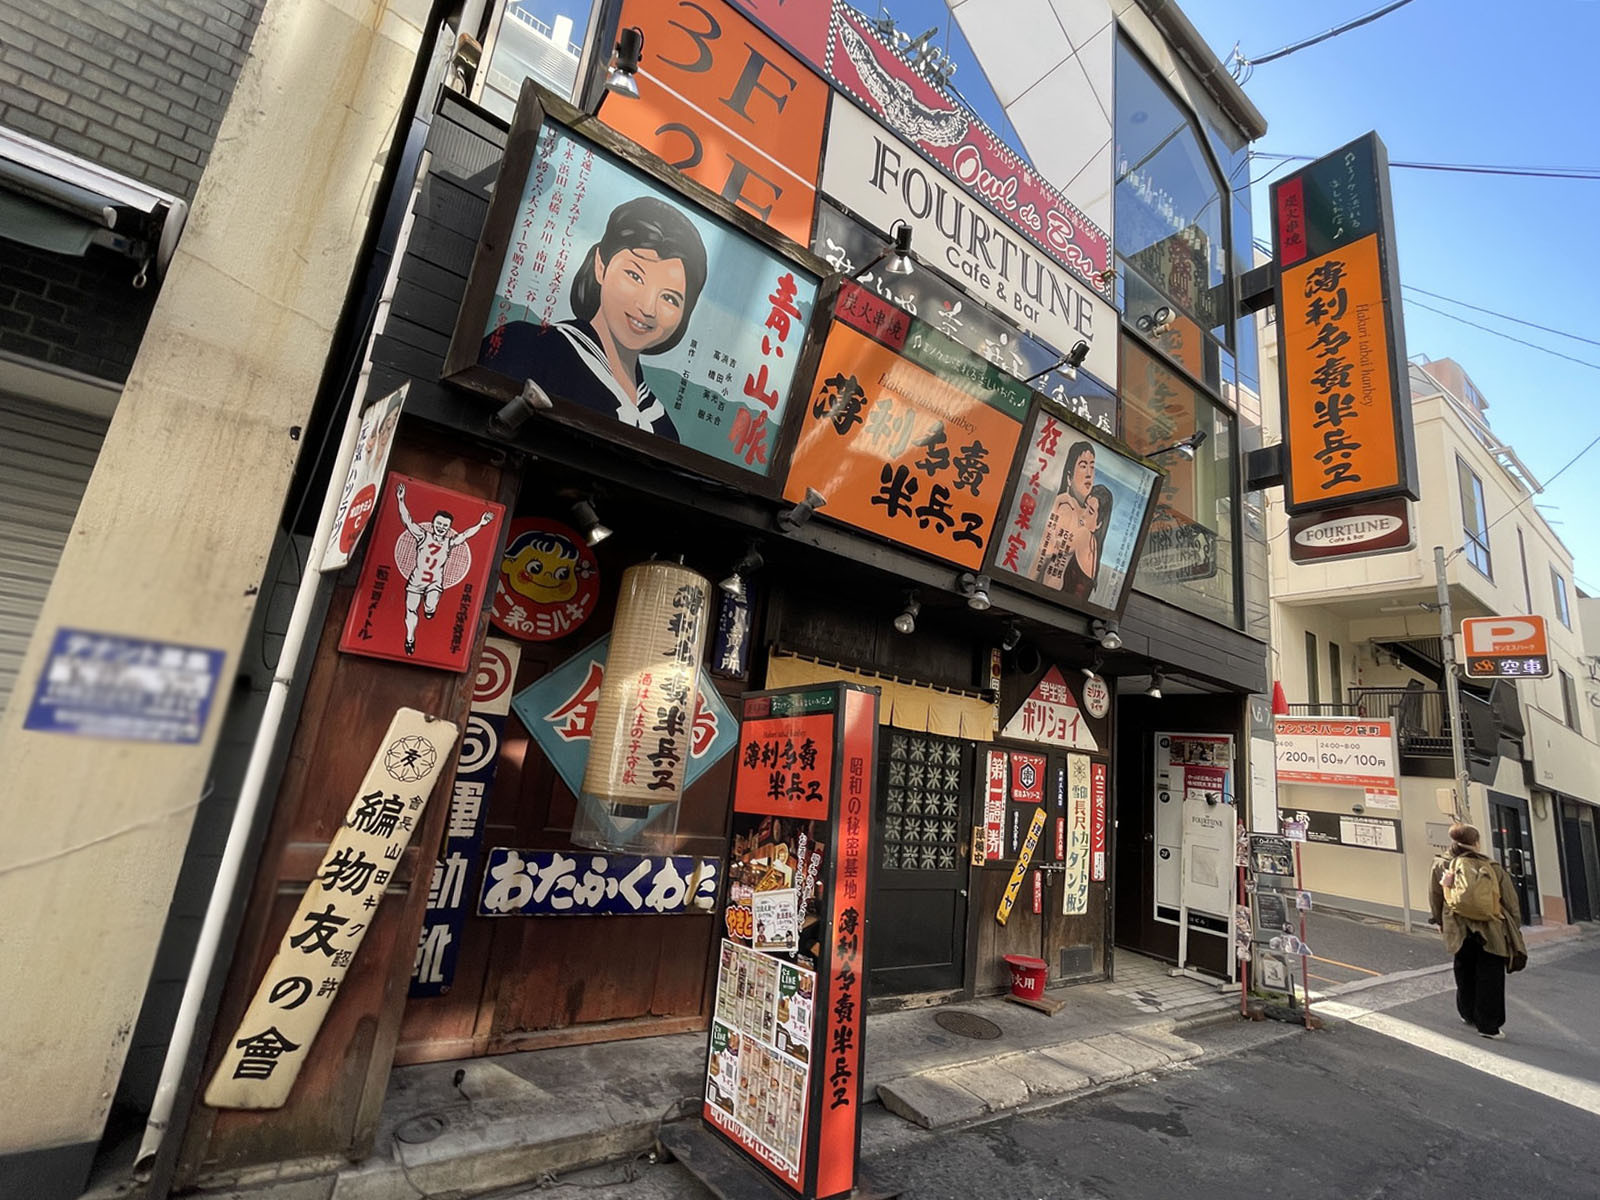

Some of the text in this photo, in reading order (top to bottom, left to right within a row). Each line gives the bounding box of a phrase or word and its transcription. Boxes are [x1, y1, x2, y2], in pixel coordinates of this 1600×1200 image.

[656, 1, 797, 124] 3F
[868, 135, 1095, 341] FOURTUNE
[951, 144, 1017, 211] Owl
[1019, 204, 1041, 230] de
[1046, 209, 1105, 292] Base
[946, 247, 990, 289] Cafe
[996, 283, 1008, 302] &
[1014, 292, 1040, 324] Bar
[1356, 303, 1368, 341] Hakuri
[728, 272, 803, 466] 青い山脈
[1361, 368, 1373, 408] hanbey
[1000, 416, 1064, 574] 狂った果実
[1306, 518, 1390, 541] FOURTUNE
[1472, 621, 1536, 652] P
[1500, 659, 1542, 674] 空車
[1040, 681, 1067, 704] 学生服
[843, 757, 865, 900] 昭和の秘密基地
[1074, 800, 1087, 830] 長尺
[484, 850, 716, 912] おたふくわた
[1066, 831, 1079, 912] トタン板
[1077, 831, 1089, 912] カラートタン
[232, 789, 405, 1081] 編物友の會
